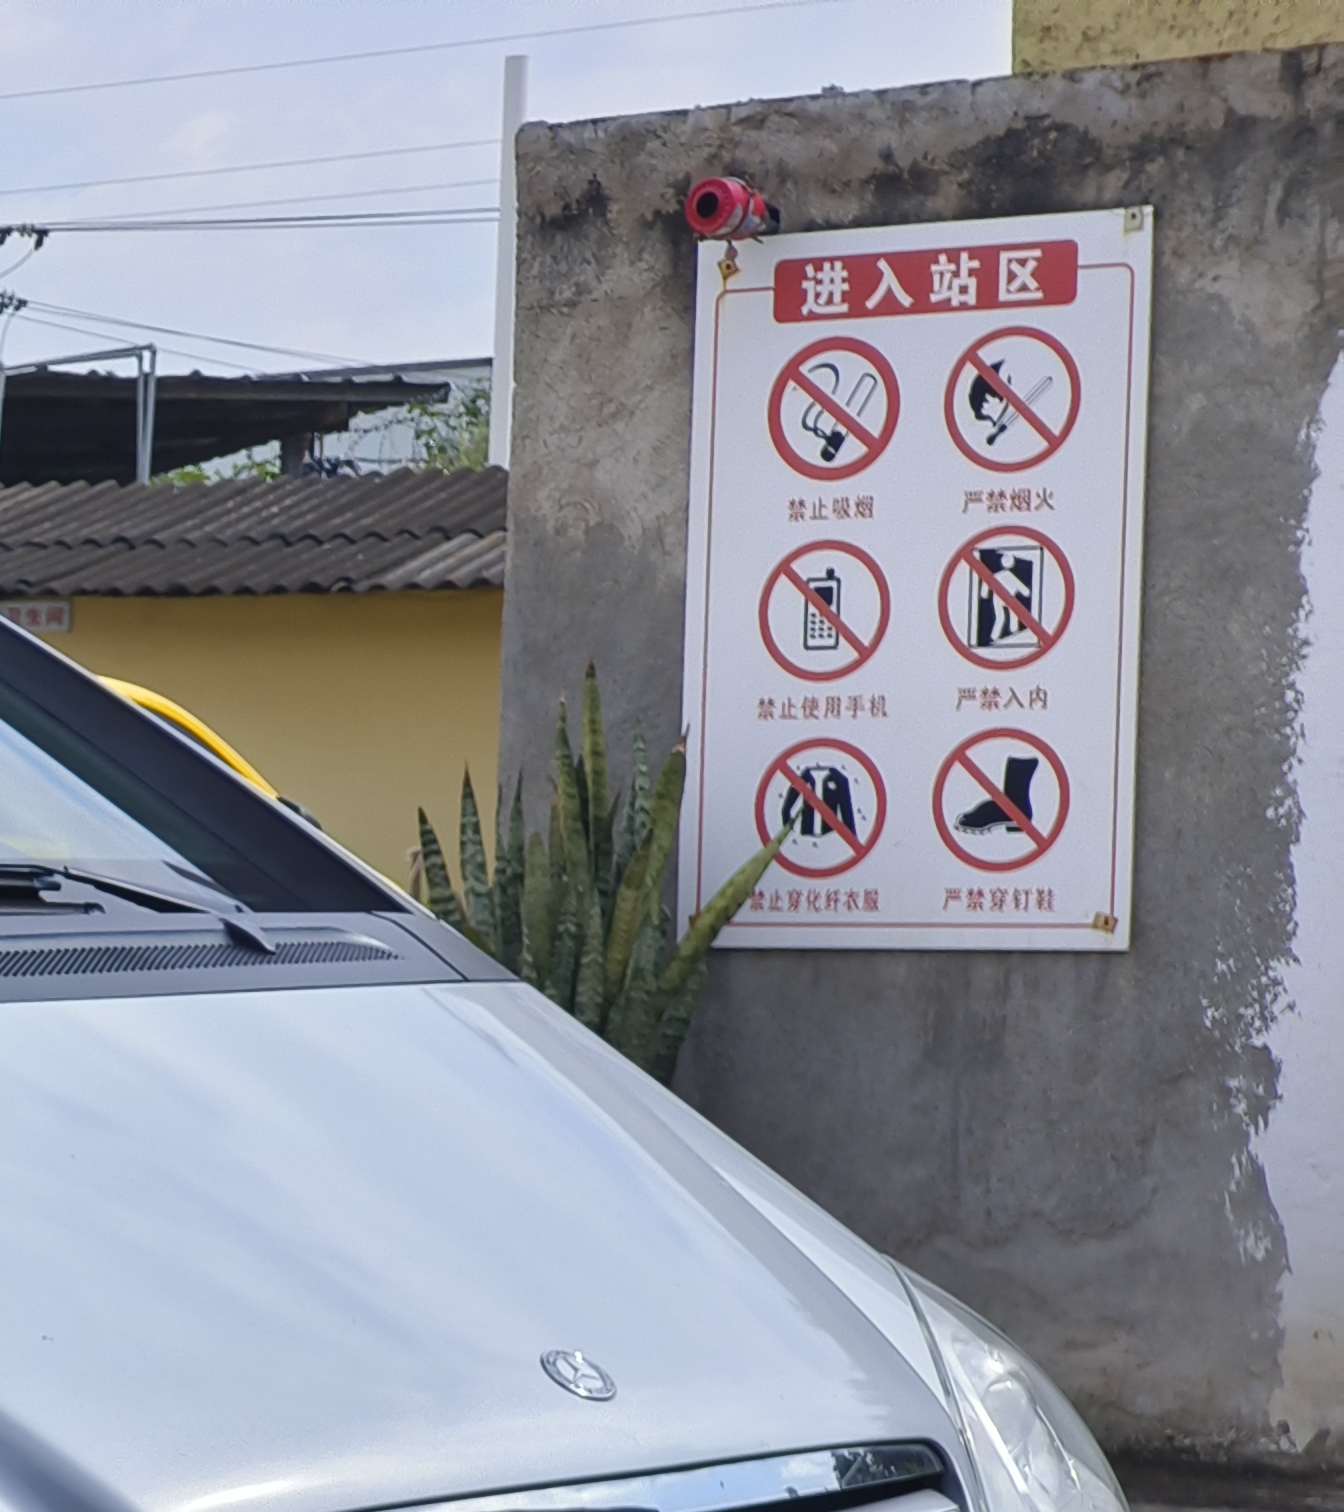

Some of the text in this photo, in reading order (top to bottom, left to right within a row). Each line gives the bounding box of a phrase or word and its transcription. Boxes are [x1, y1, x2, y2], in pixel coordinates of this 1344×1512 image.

[801, 248, 1044, 317] 进入站区
[786, 494, 875, 523] 禁止吸烟
[961, 487, 1056, 514] 严禁烟火
[756, 692, 889, 722] 禁止使用手机
[955, 684, 1049, 712] 严禁入内
[749, 887, 881, 913] 禁止穿化纤衣服
[942, 886, 1057, 913] 严禁穿钉鞋
